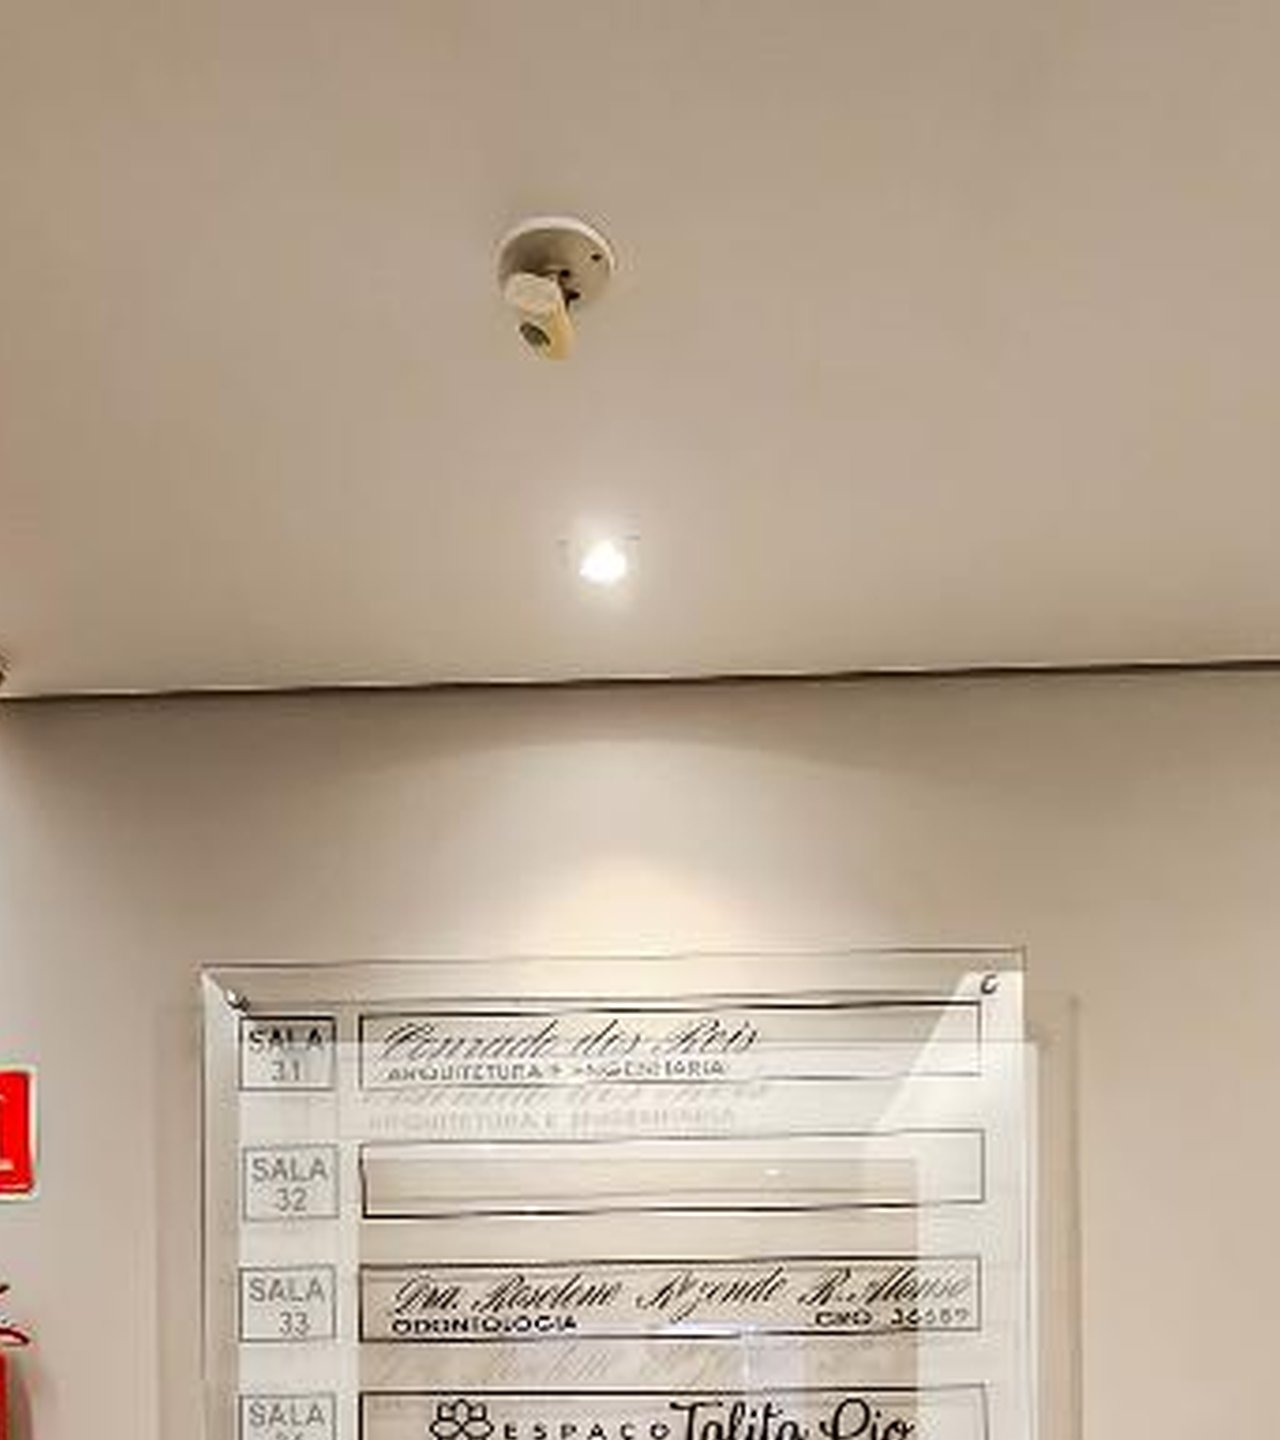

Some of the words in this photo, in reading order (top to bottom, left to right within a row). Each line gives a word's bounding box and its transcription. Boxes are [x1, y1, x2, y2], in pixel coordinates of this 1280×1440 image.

[247, 1024, 322, 1051] SALA
[251, 1157, 328, 1182] SALA
[274, 1187, 308, 1212] 32
[248, 1276, 325, 1301] SALA
[279, 1311, 310, 1335] 33
[391, 1315, 577, 1334] ODONTOLOGIA
[248, 1402, 325, 1427] SALA
[503, 1423, 669, 1440] ESPAÇO
